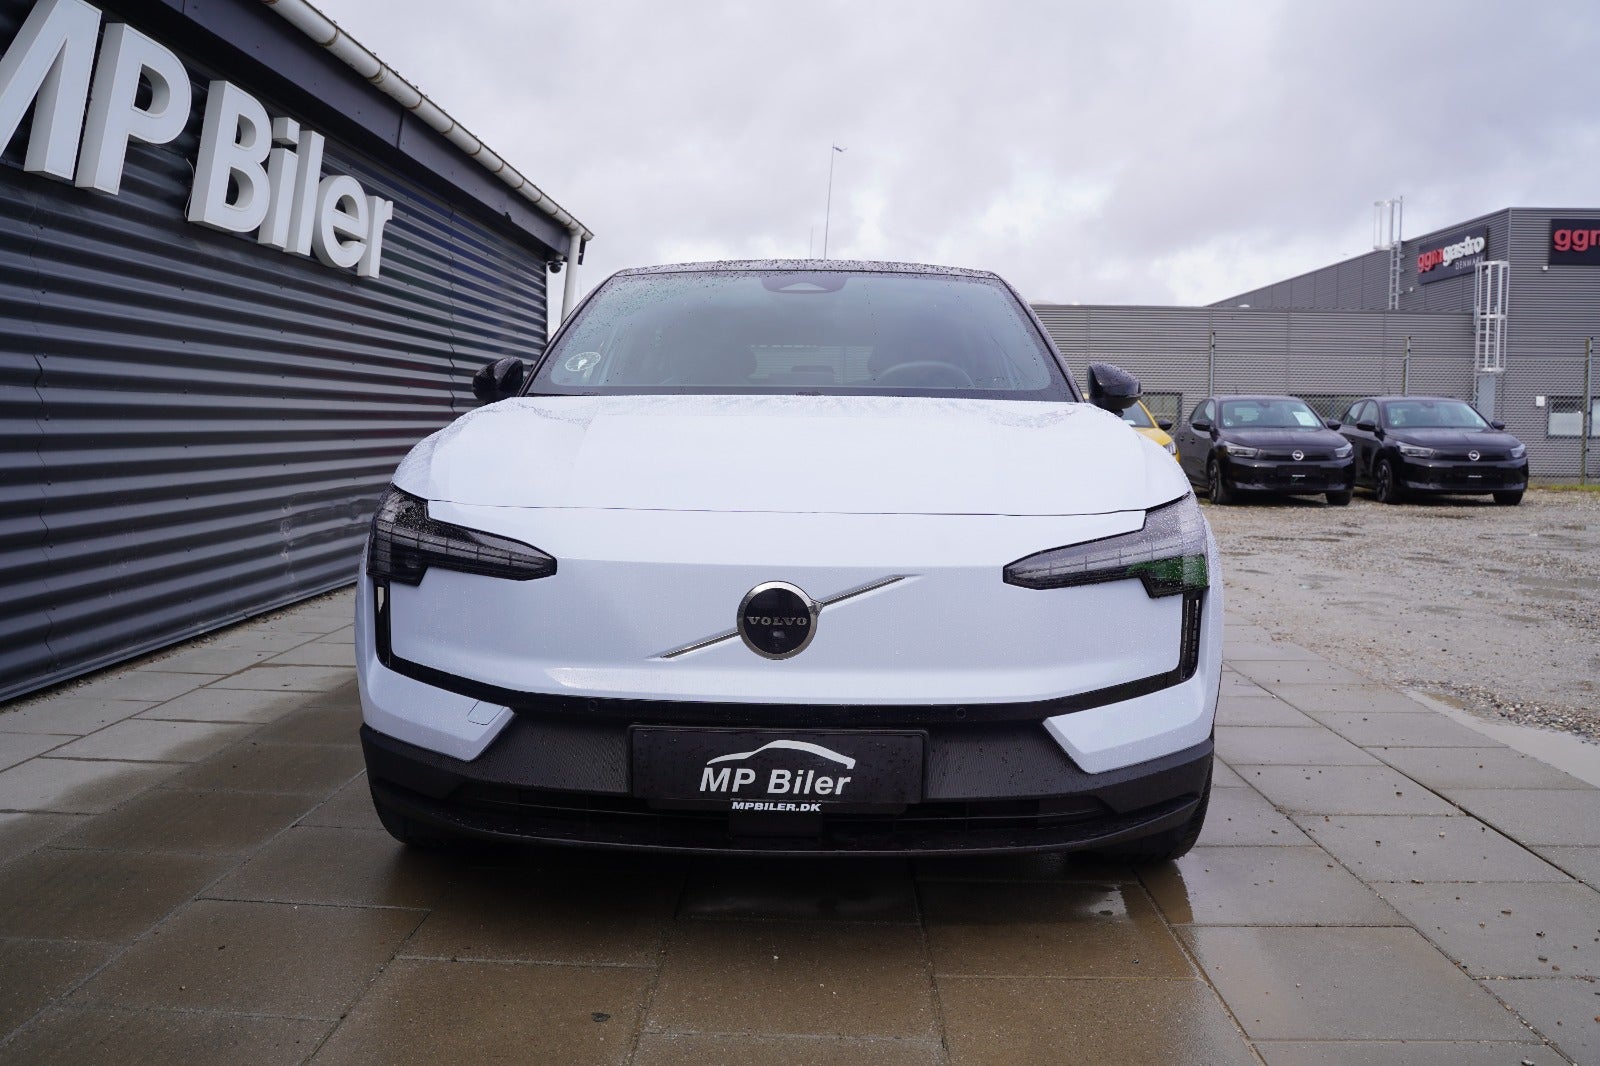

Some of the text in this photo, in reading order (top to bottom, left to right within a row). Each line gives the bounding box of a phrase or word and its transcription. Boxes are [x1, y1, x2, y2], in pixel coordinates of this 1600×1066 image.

[188, 80, 393, 279] Biler
[746, 616, 808, 626] VOLVO
[700, 767, 852, 795] MP Biler
[731, 801, 821, 812] MPBILER.DK
